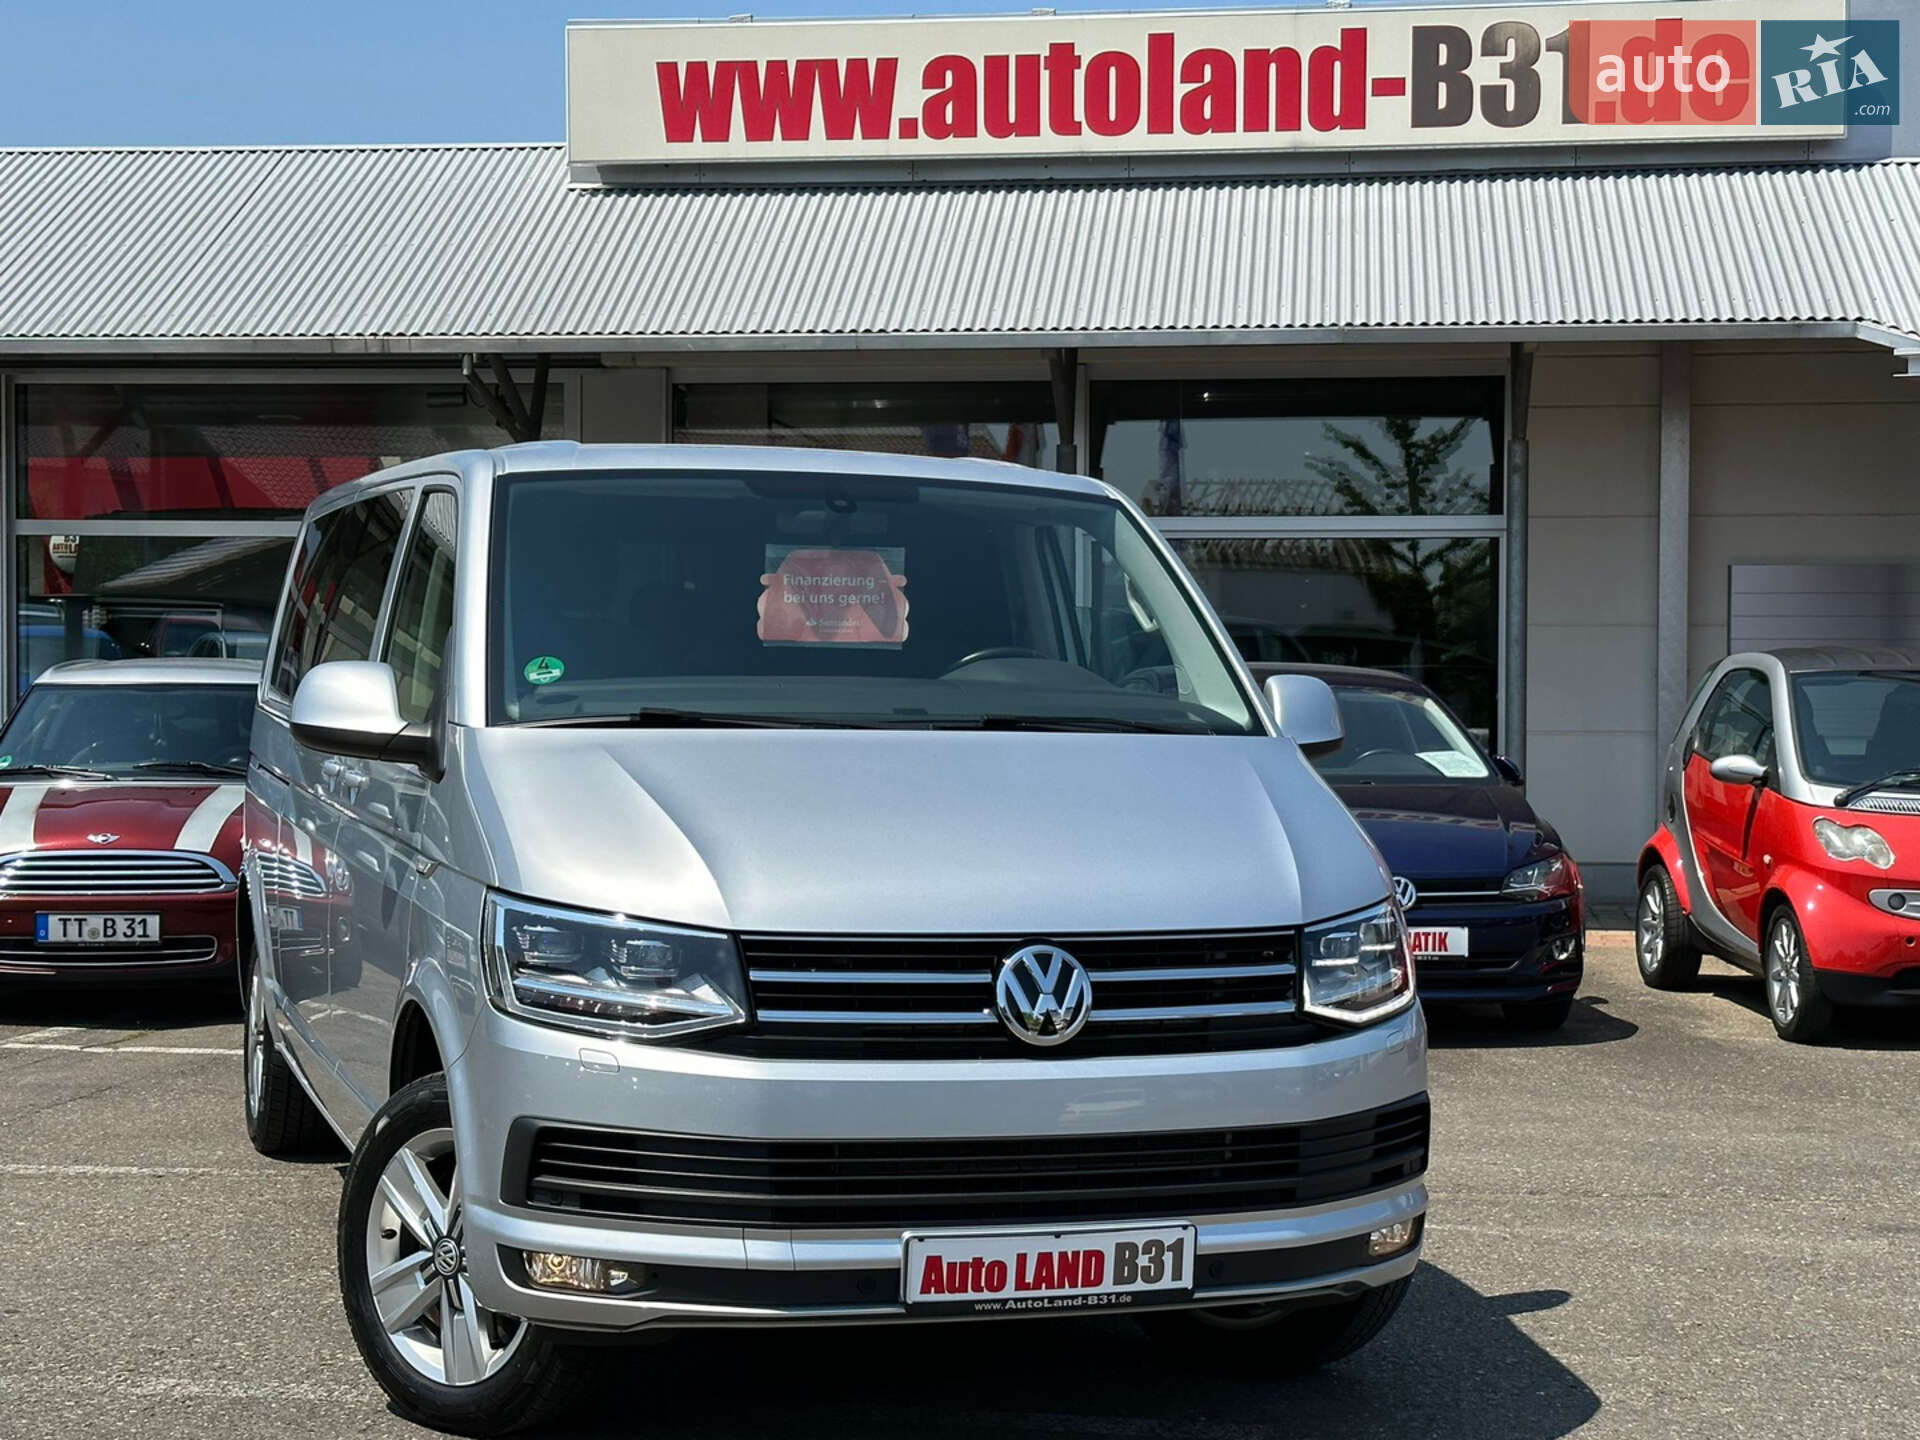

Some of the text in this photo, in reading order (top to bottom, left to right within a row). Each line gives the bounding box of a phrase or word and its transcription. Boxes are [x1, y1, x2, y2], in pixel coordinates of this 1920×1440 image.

[783, 573, 875, 589] Finanzierung
[783, 590, 886, 607] bei uns gerne!
[537, 656, 550, 670] 4
[57, 917, 150, 938] TT B 31
[1407, 931, 1449, 953] ATIK
[919, 1237, 1185, 1295] Auto LAND B31
[974, 1293, 1132, 1312] www.AutoLand-B31.de
